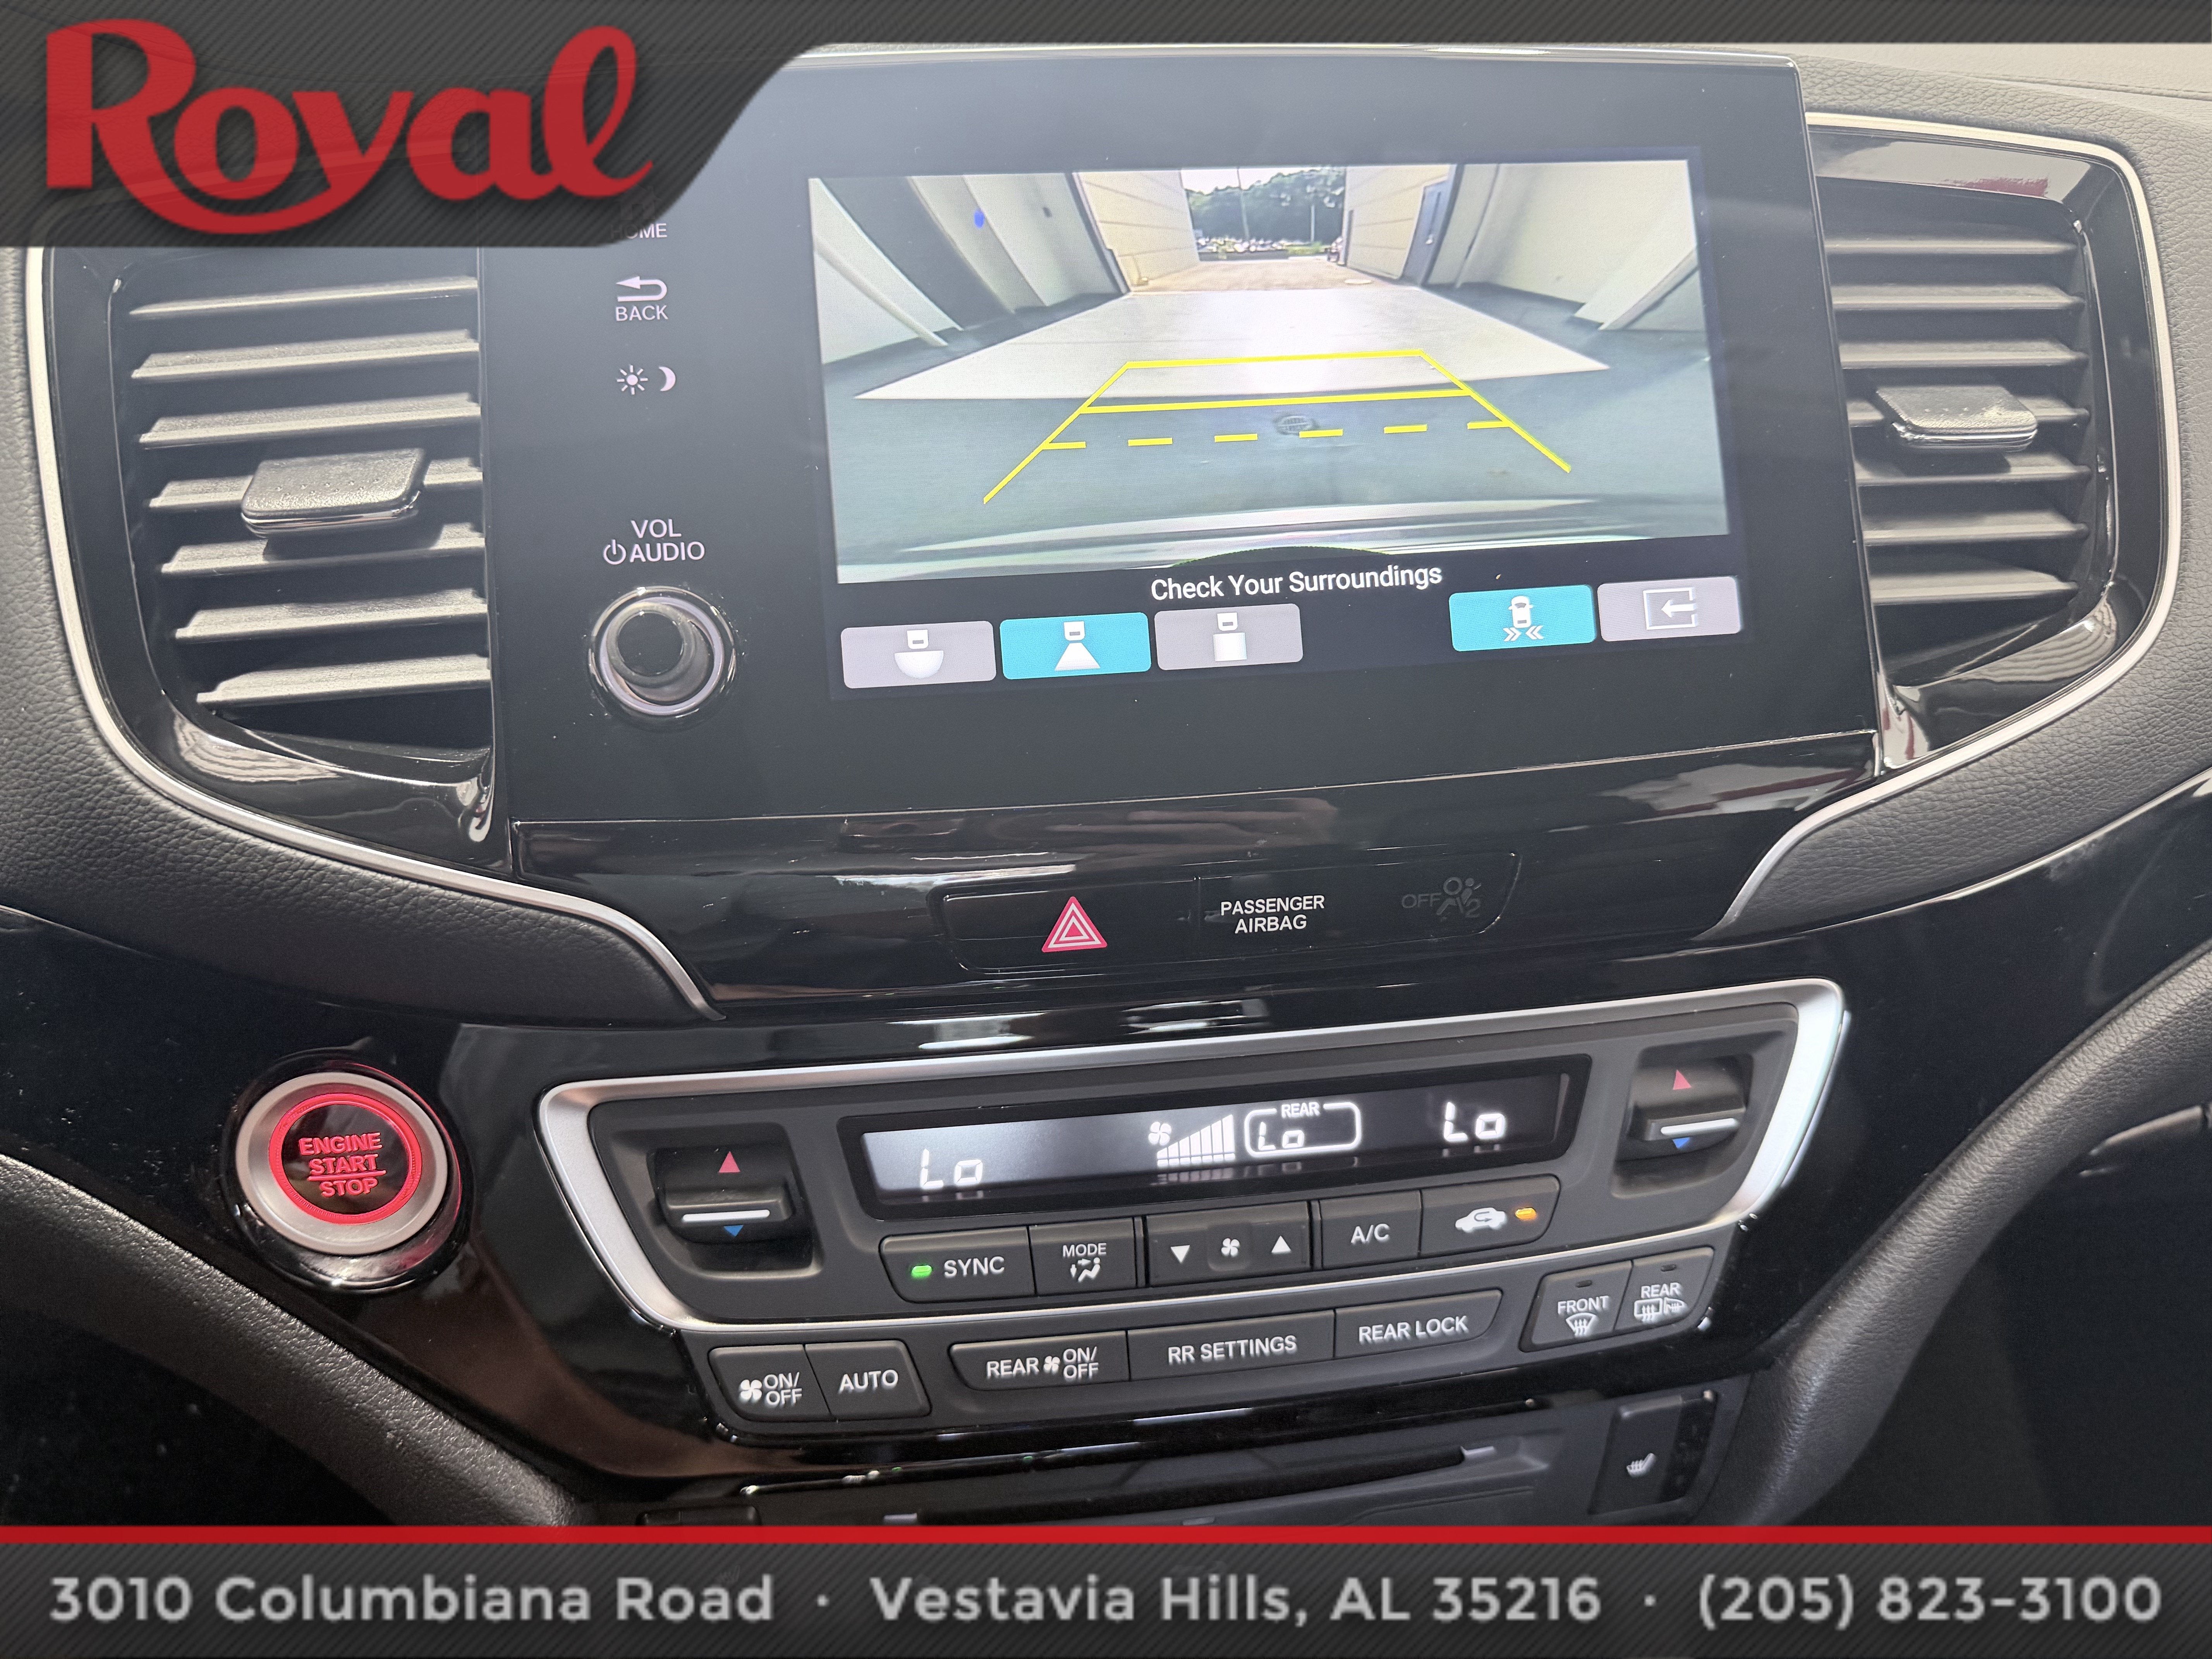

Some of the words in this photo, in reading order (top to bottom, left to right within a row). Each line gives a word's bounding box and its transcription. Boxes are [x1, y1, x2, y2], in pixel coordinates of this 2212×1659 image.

[615, 305, 668, 321] BACK
[631, 519, 682, 538] VOL
[630, 541, 705, 563] AUDIO
[1151, 576, 1224, 600] Check
[1228, 575, 1283, 595] Your
[1289, 565, 1443, 592] Surroundings
[1220, 895, 1325, 916] PASSENGER
[1401, 893, 1443, 908] OFF
[1235, 915, 1307, 934] AIRBAG
[1281, 1102, 1320, 1118] REAR
[298, 1132, 383, 1155] ENGINE
[309, 1154, 378, 1175] START
[319, 1178, 378, 1197] STOP
[1351, 1223, 1390, 1245] A/C
[1062, 1242, 1106, 1258] MODE
[943, 1256, 1005, 1279] SYNC
[1640, 1283, 1681, 1298] REAR
[1557, 1295, 1609, 1314] FRONT
[1359, 1322, 1413, 1343] REAR
[1415, 1315, 1469, 1337] LOCK
[1063, 1346, 1097, 1363] ON/
[1167, 1345, 1195, 1364] RR
[1200, 1334, 1297, 1361] SETTINGS
[986, 1357, 1039, 1377] REAR
[1063, 1362, 1099, 1379] OFF
[764, 1371, 800, 1389] ON/
[838, 1369, 898, 1392] AUTO
[766, 1389, 802, 1405] OFF
